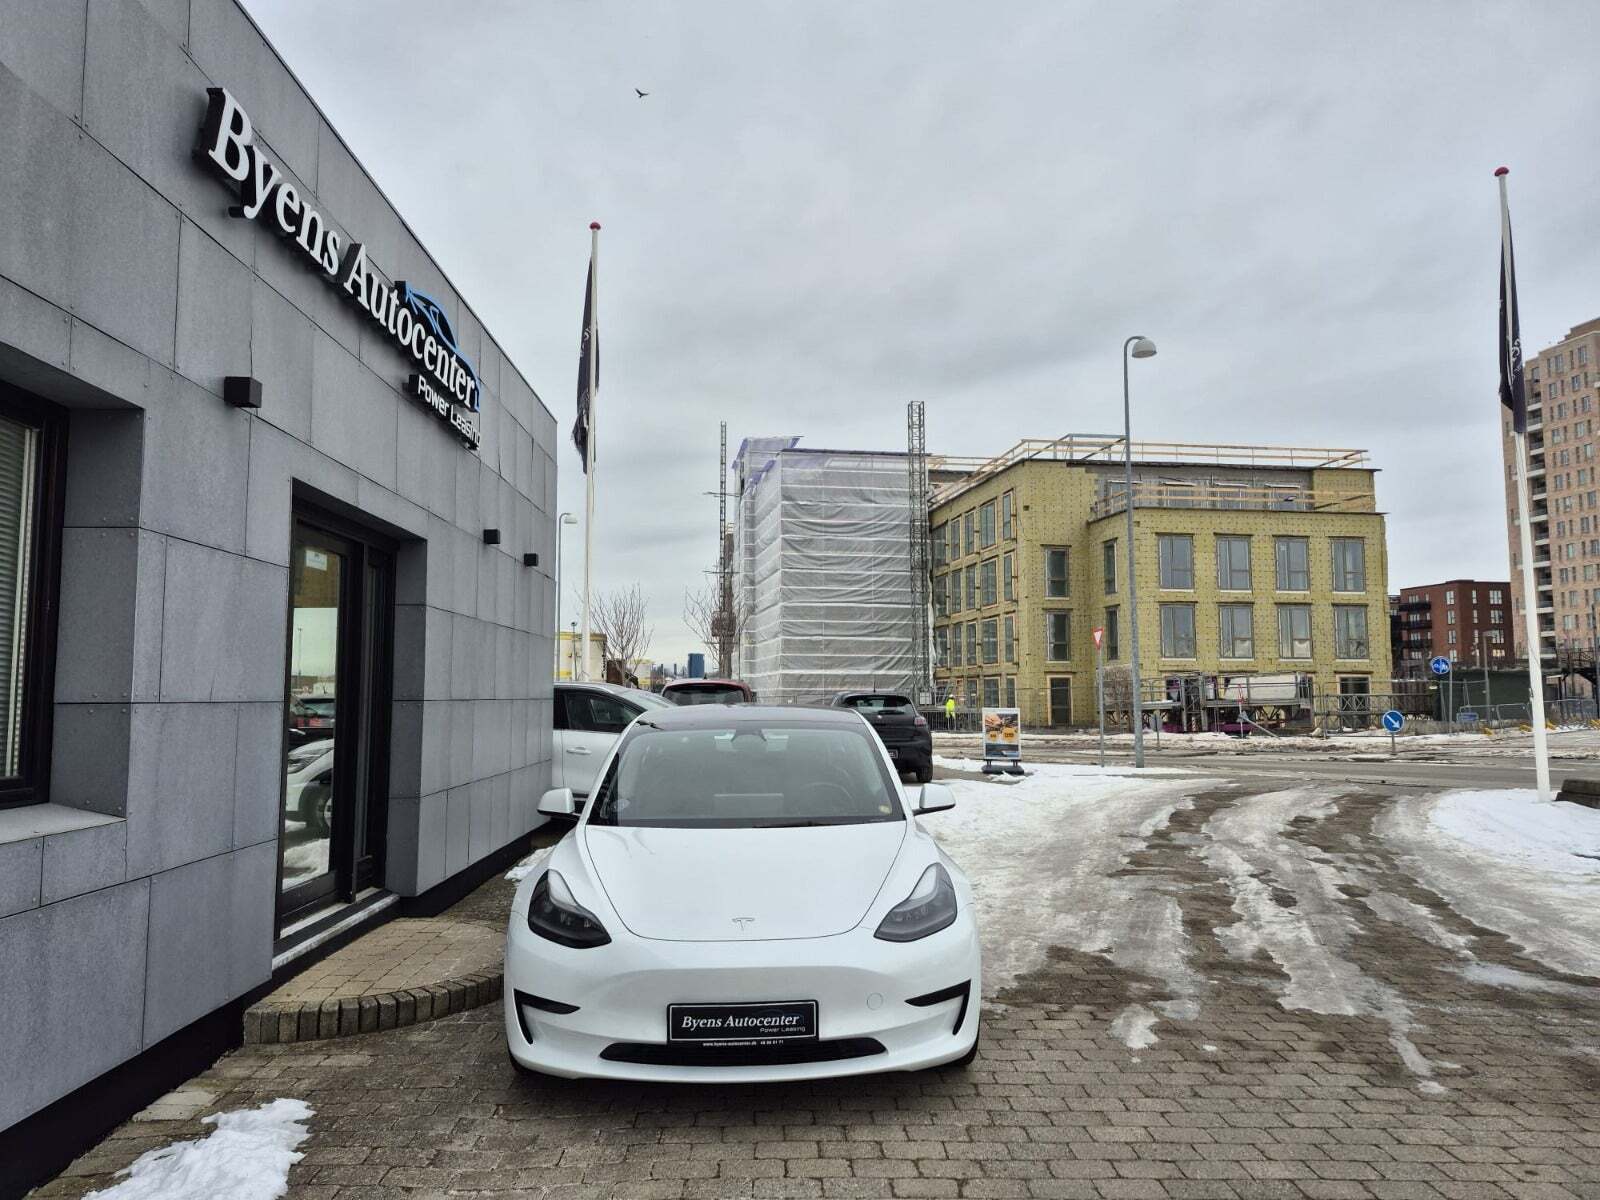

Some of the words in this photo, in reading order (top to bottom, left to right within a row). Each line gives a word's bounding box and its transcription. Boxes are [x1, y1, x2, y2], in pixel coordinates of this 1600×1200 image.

[208, 87, 341, 275] Byens
[343, 243, 475, 408] Autocenter
[417, 374, 449, 417] Power
[681, 1015, 722, 1031] Byens
[724, 1014, 800, 1028] Autocenter
